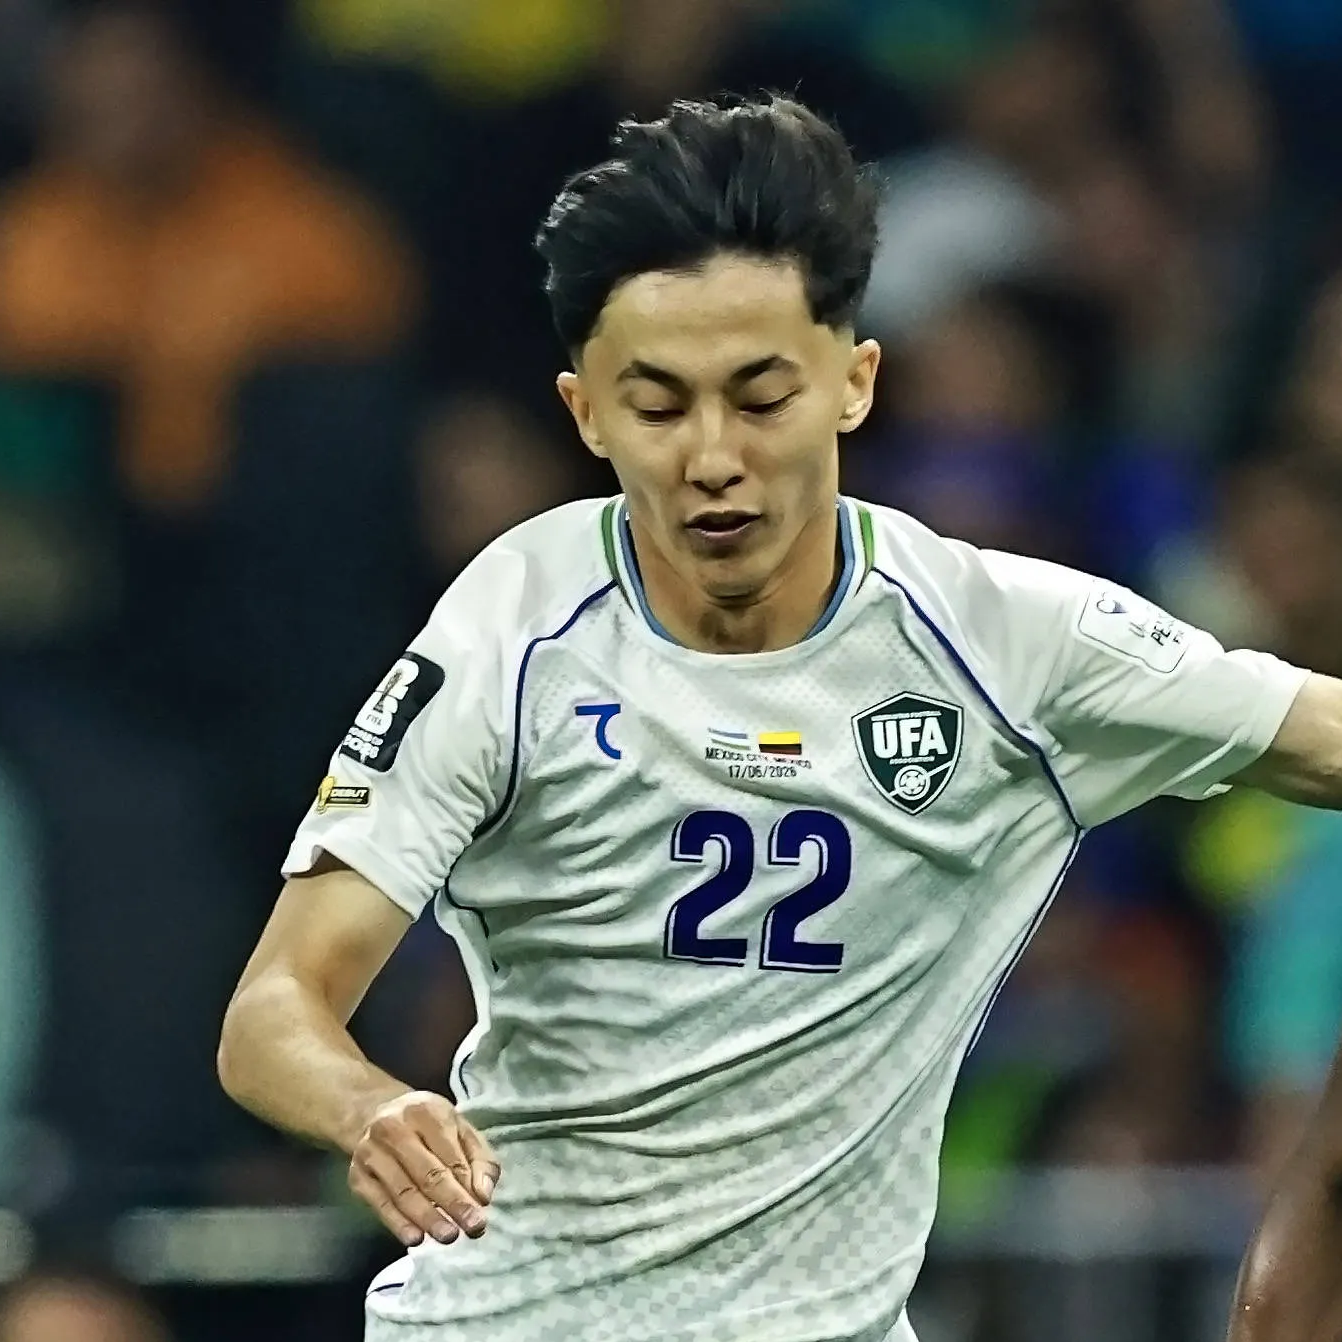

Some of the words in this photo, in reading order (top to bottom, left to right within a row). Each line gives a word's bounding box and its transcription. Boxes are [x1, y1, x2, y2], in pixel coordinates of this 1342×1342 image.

[871, 716, 948, 759] UFA
[728, 765, 797, 778] 17/06/2026
[330, 788, 367, 798] DEBUT
[664, 809, 852, 974] 22
